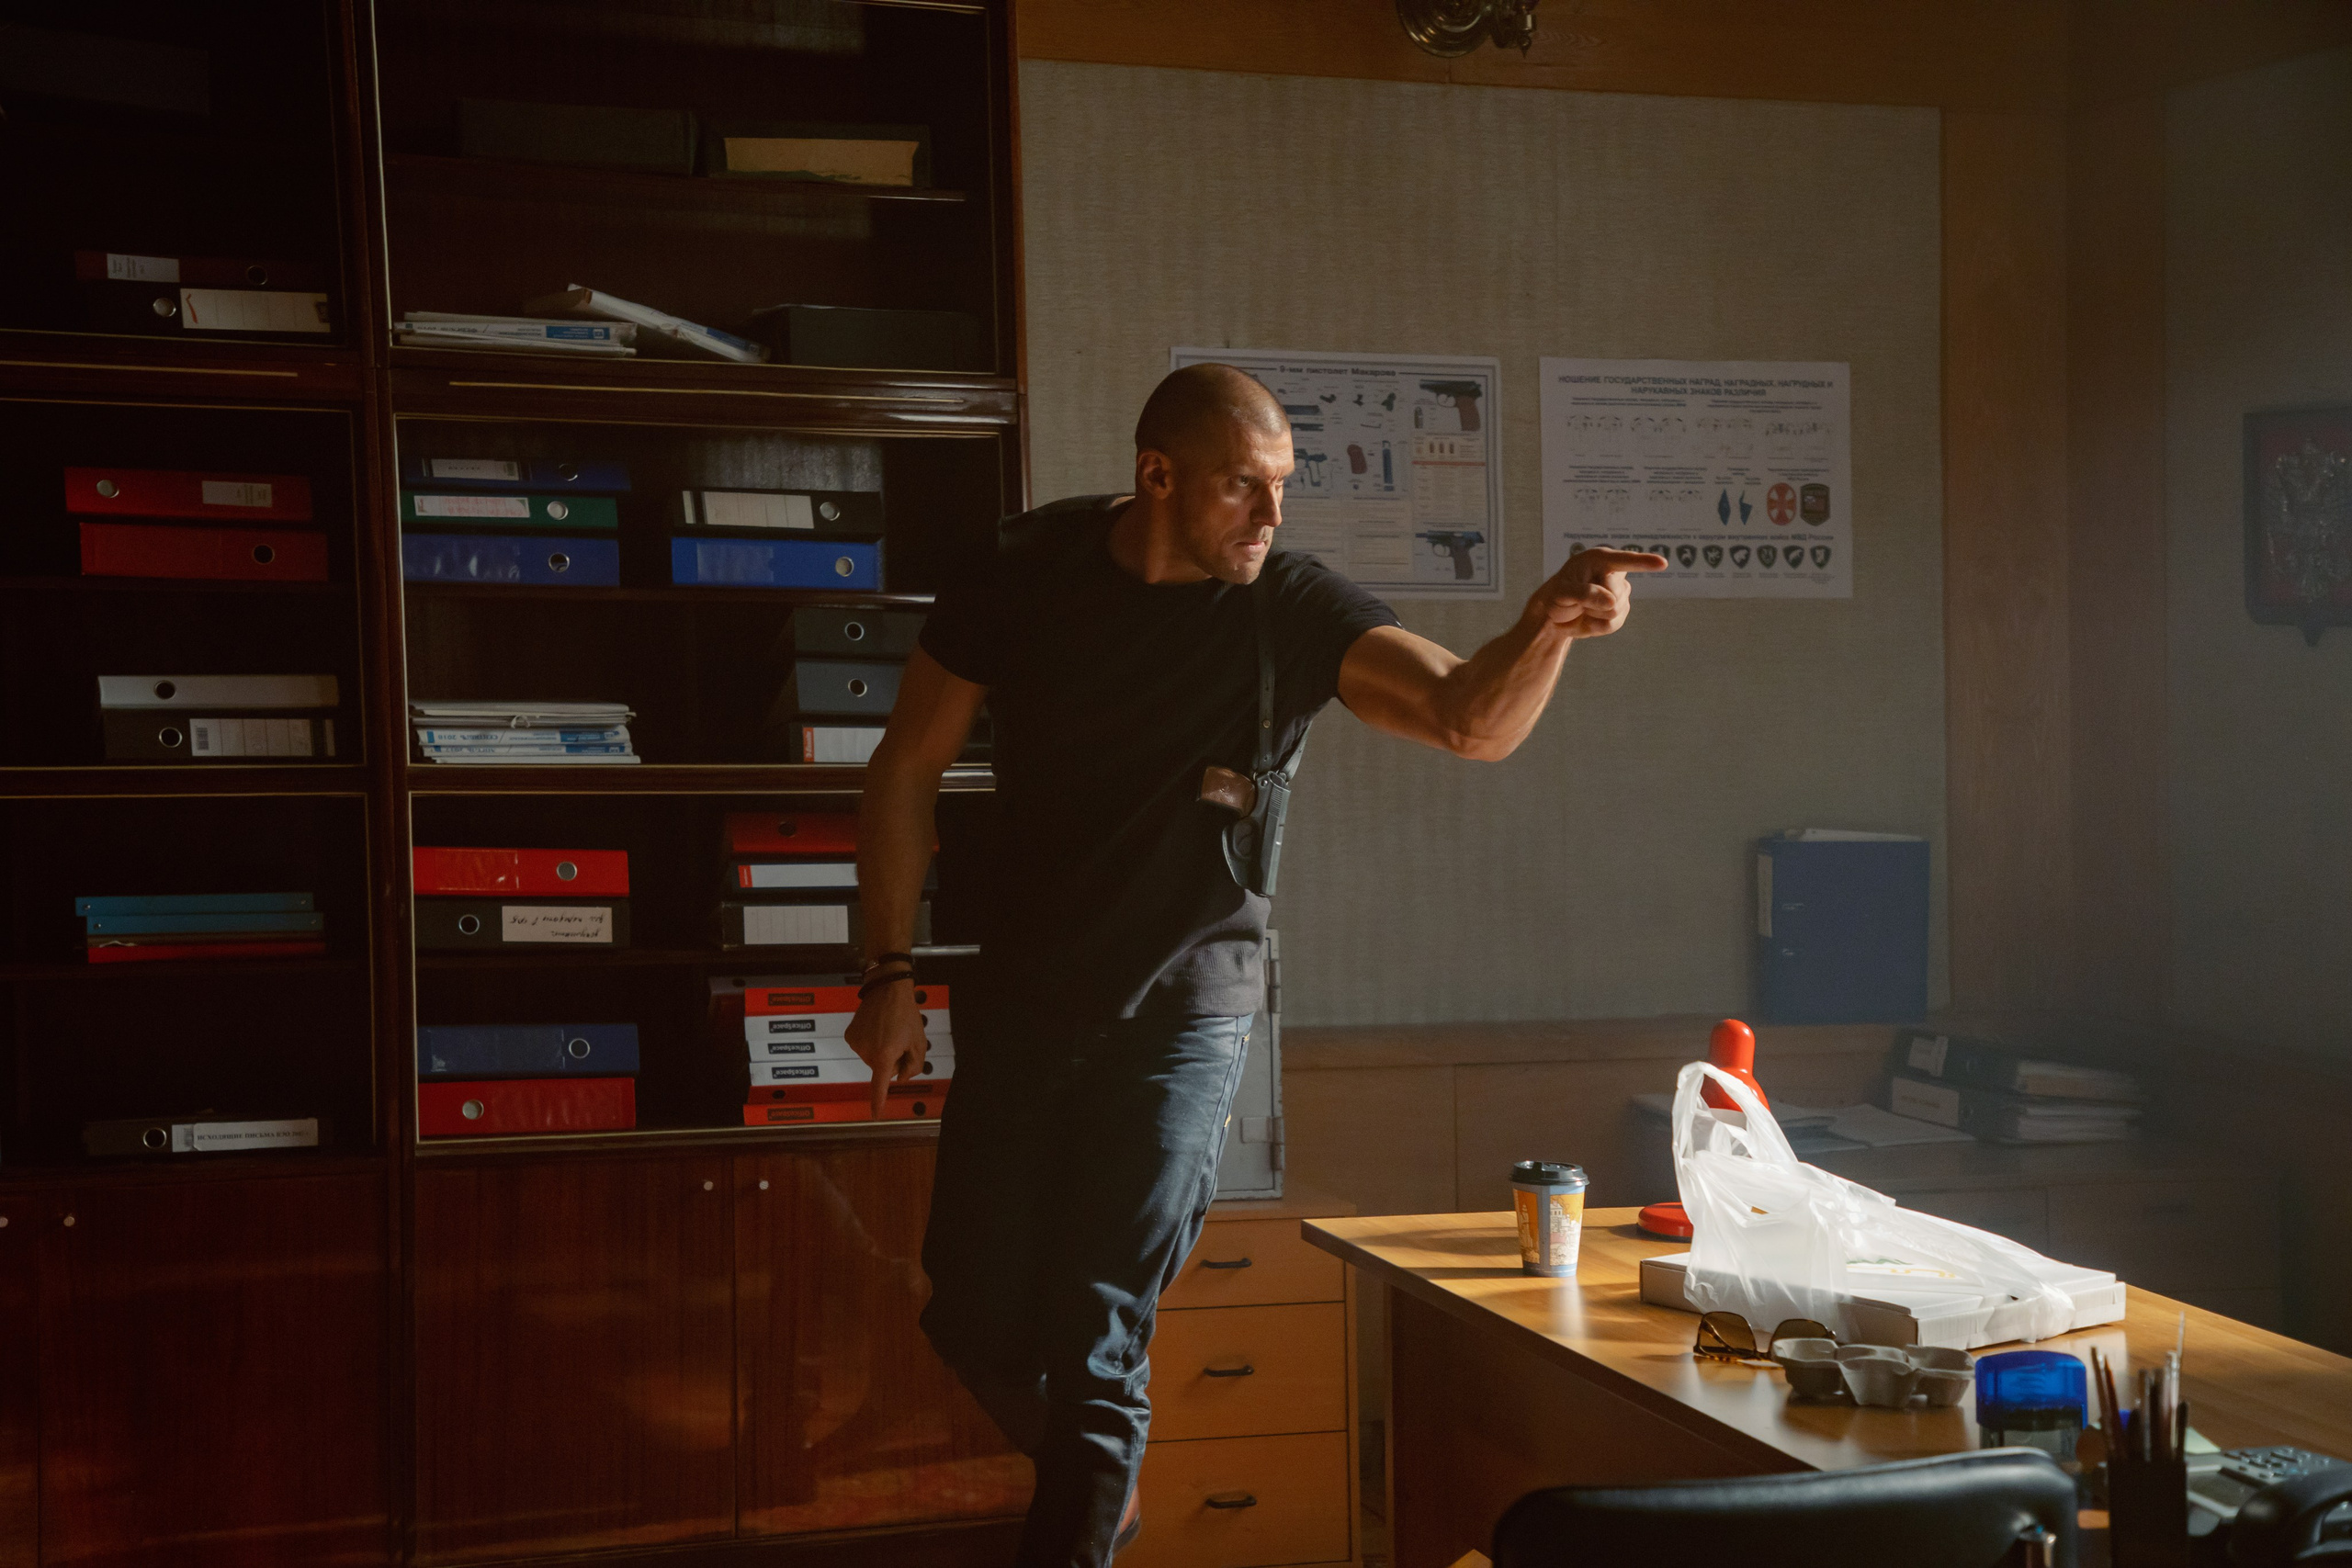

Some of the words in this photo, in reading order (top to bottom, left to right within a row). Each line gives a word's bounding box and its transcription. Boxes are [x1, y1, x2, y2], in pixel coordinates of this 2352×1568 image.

[1351, 367, 1396, 377] Макарова
[1558, 376, 1600, 384] НОШЕНИЕ
[1603, 376, 1687, 385] ГОСУДАРСТВЕННЫХ
[1631, 387, 1688, 395] НАРУКАВНЫХ
[1690, 388, 1723, 396] ЗНАКОВ
[769, 1021, 812, 1032] OfficeSpace
[769, 1043, 811, 1054] OfficeSpace
[773, 1067, 815, 1077] OfficeSpace
